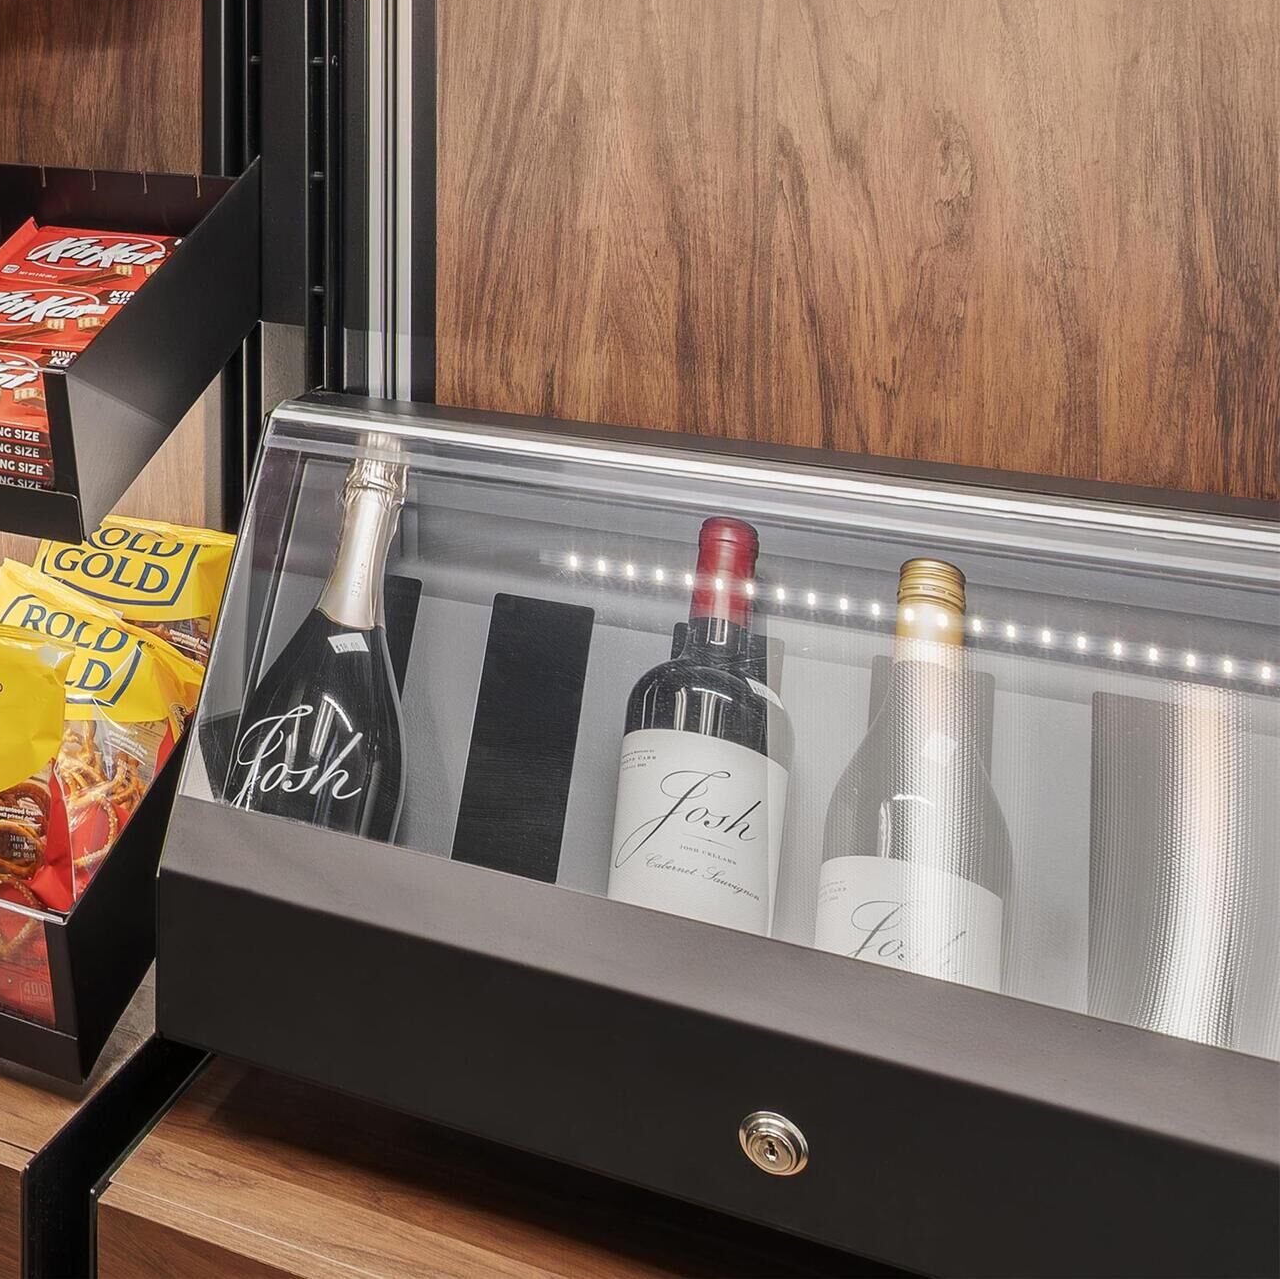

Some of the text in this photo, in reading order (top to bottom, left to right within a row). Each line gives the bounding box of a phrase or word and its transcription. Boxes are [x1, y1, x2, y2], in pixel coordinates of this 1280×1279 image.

[14, 445, 40, 457] SIZE
[18, 462, 44, 475] SIZE
[53, 548, 171, 594] GOLD
[230, 704, 363, 811] Josh
[614, 770, 762, 869] Josh
[645, 853, 760, 901] Cabernet Sauvignon
[680, 844, 737, 865] JOSH CELLARS
